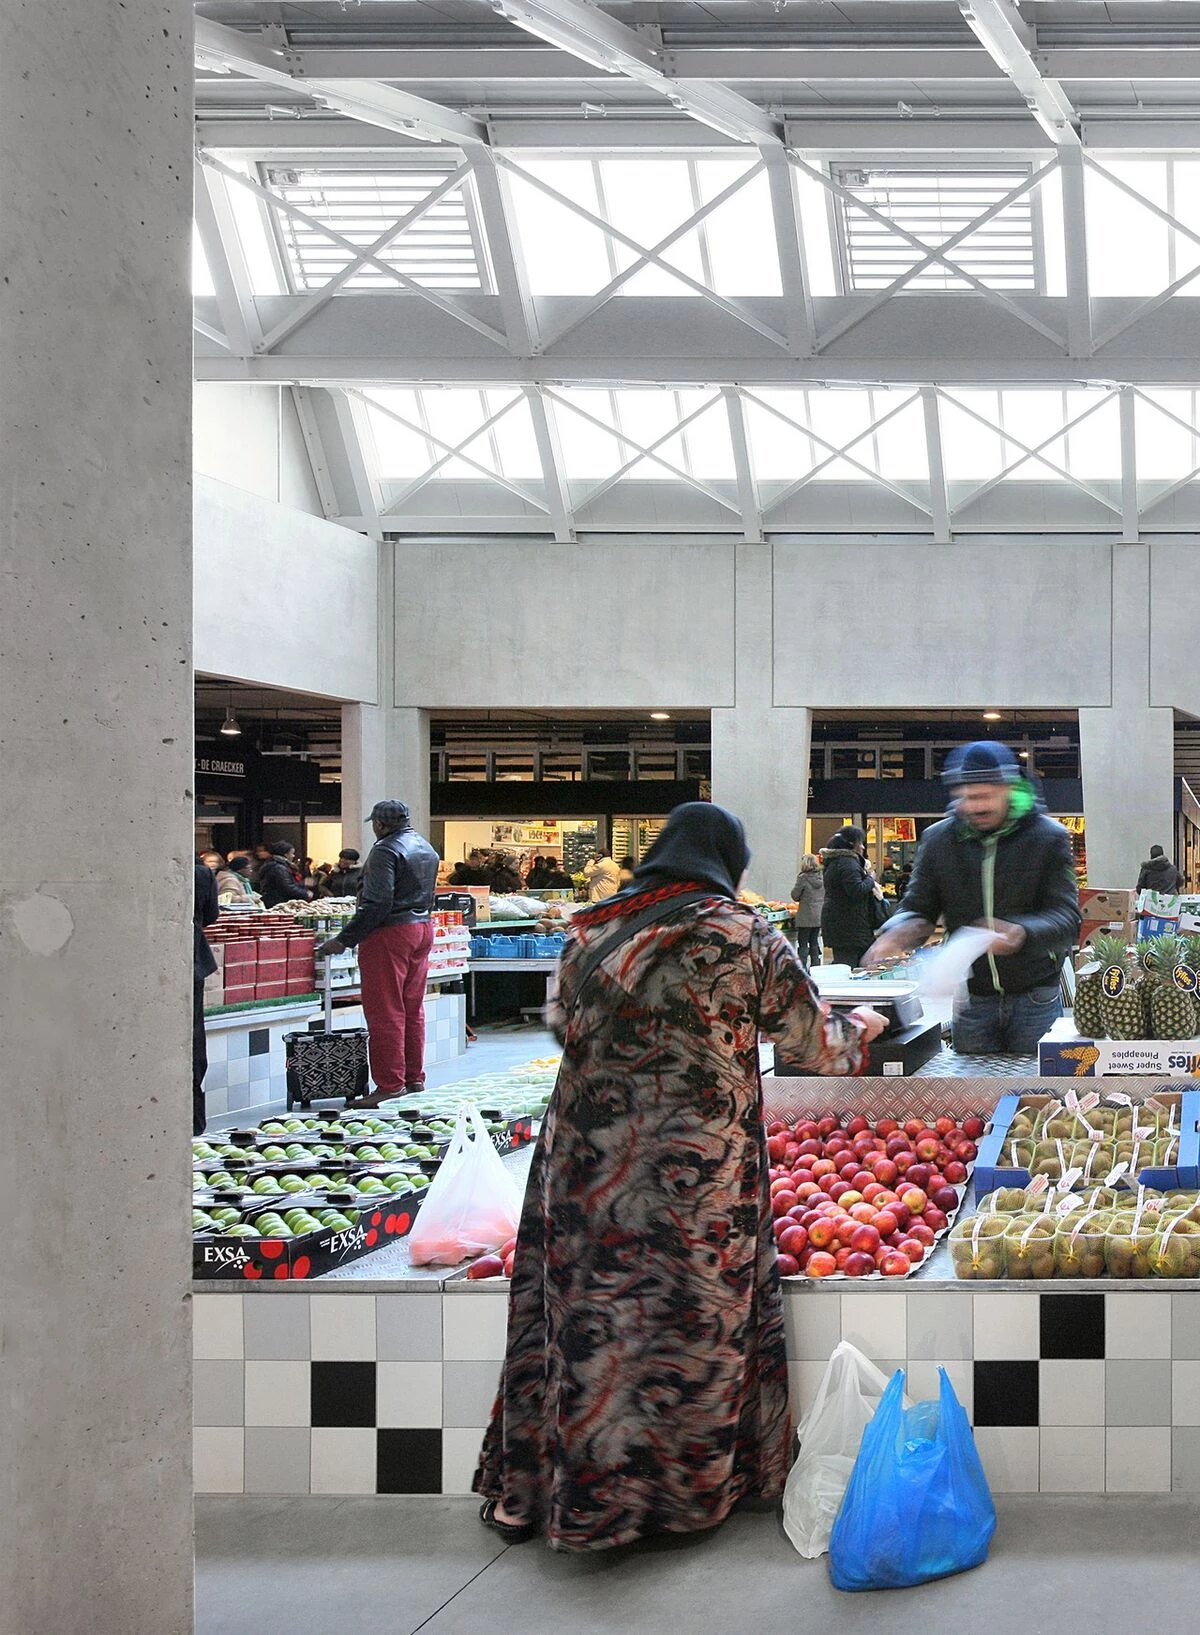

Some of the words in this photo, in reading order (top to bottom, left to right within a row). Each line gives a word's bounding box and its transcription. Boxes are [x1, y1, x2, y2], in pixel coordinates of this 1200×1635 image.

[211, 760, 244, 773] CRAECKER
[1111, 1050, 1159, 1060] Pineapples
[1108, 1061, 1134, 1071] Sweet
[1137, 1061, 1162, 1071] Super
[330, 1225, 366, 1253] EXSA
[204, 1246, 248, 1262] EXSA
